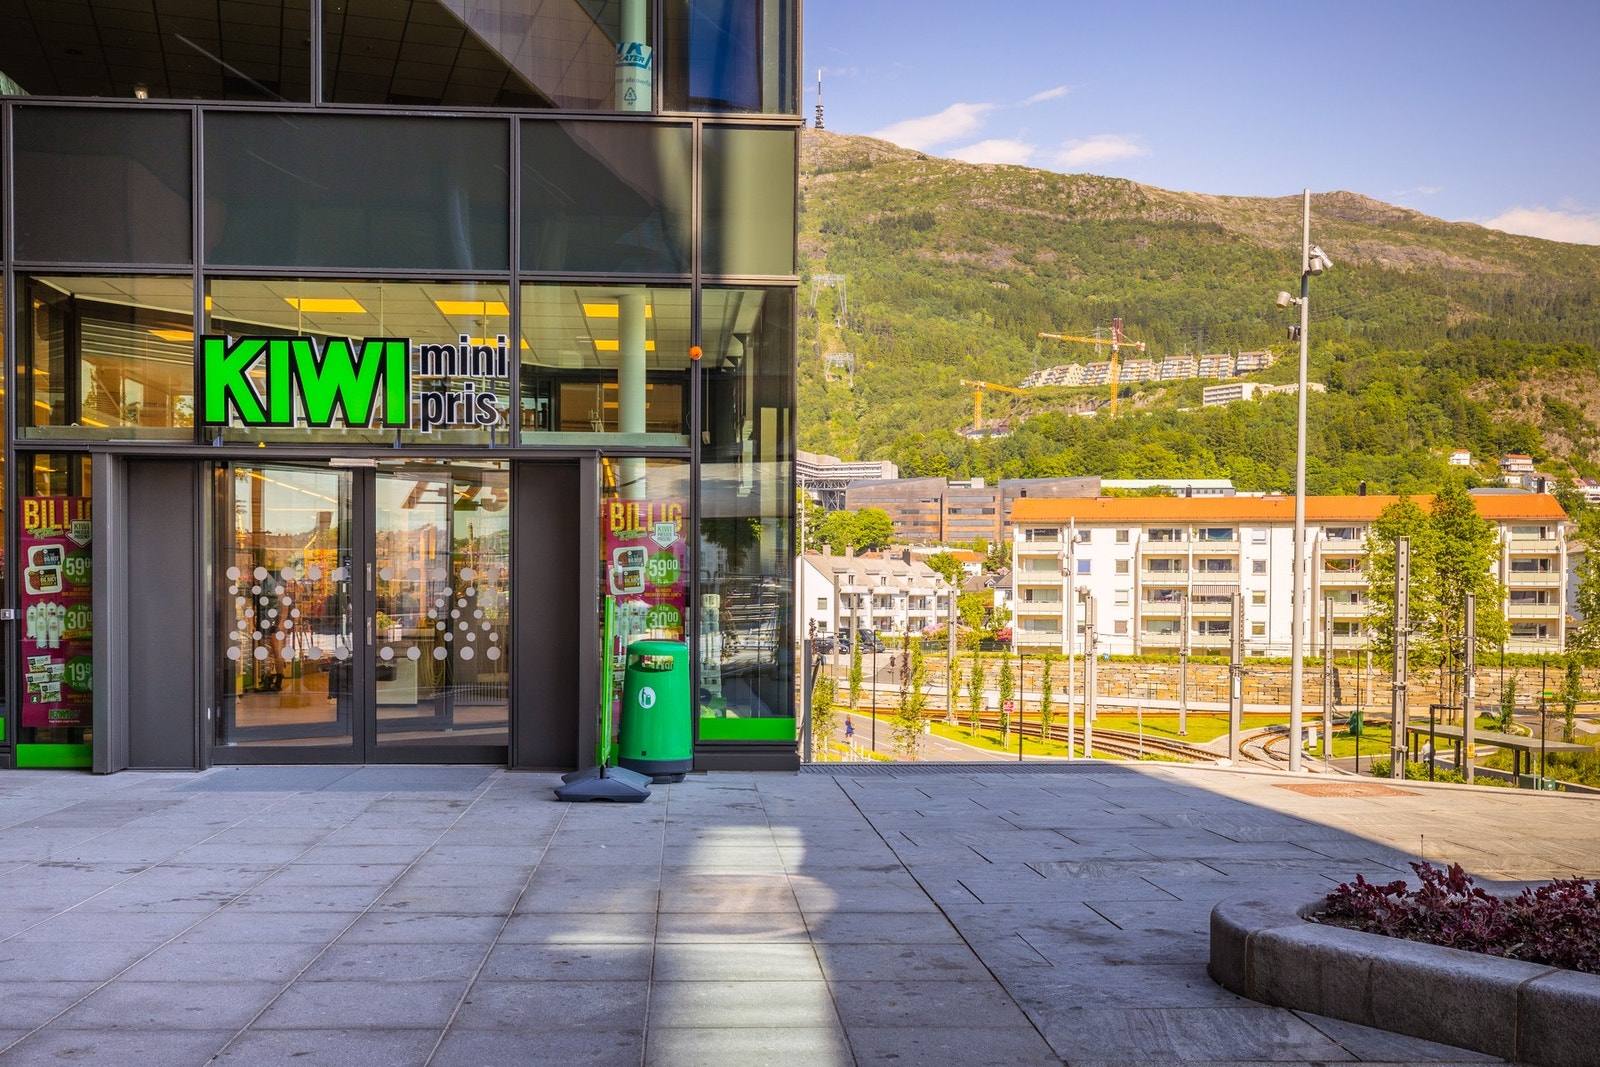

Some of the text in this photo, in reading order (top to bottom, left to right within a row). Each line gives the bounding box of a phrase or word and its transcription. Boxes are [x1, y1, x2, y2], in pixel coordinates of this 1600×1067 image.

[420, 334, 509, 377] mini
[200, 335, 412, 429] KIWI
[419, 382, 500, 433] pris
[610, 502, 682, 532] BILLIG
